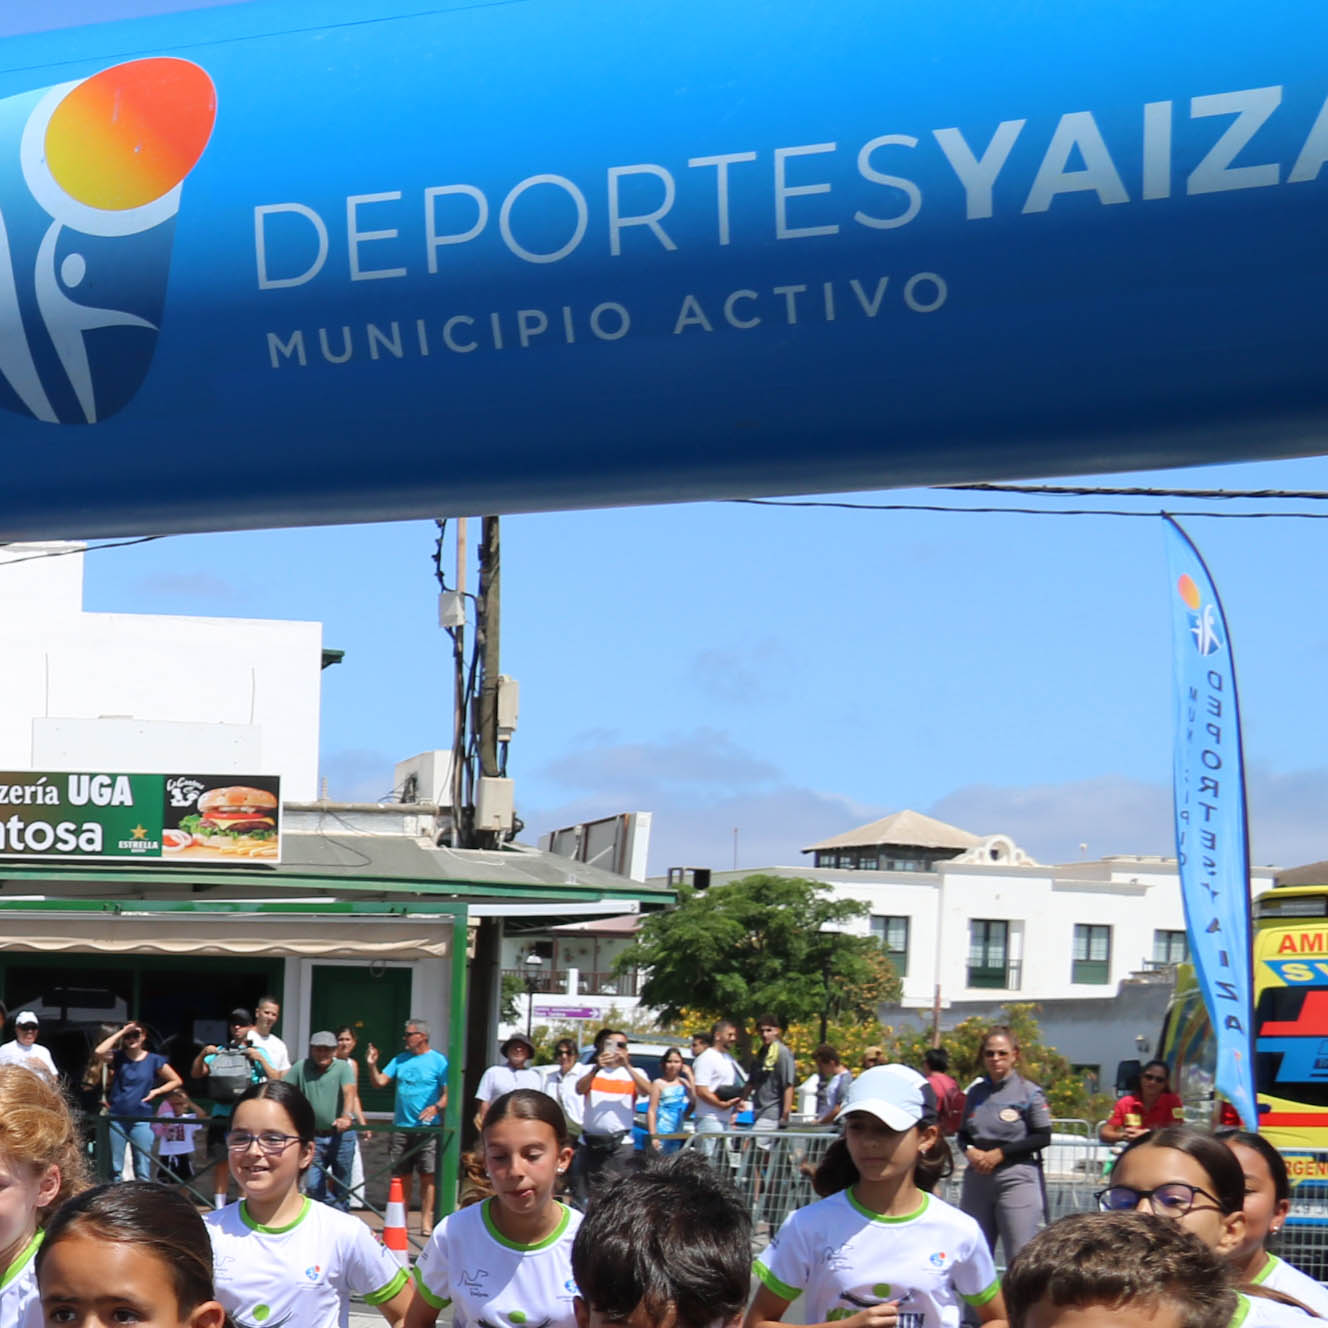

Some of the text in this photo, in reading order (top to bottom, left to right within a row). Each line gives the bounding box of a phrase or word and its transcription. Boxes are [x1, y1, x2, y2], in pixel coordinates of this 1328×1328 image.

[266, 272, 948, 369] MUNICIPIO ACTIVO
[68, 775, 134, 807] UGA
[118, 840, 159, 850] ESTRELLA
[1277, 932, 1328, 954] AM
